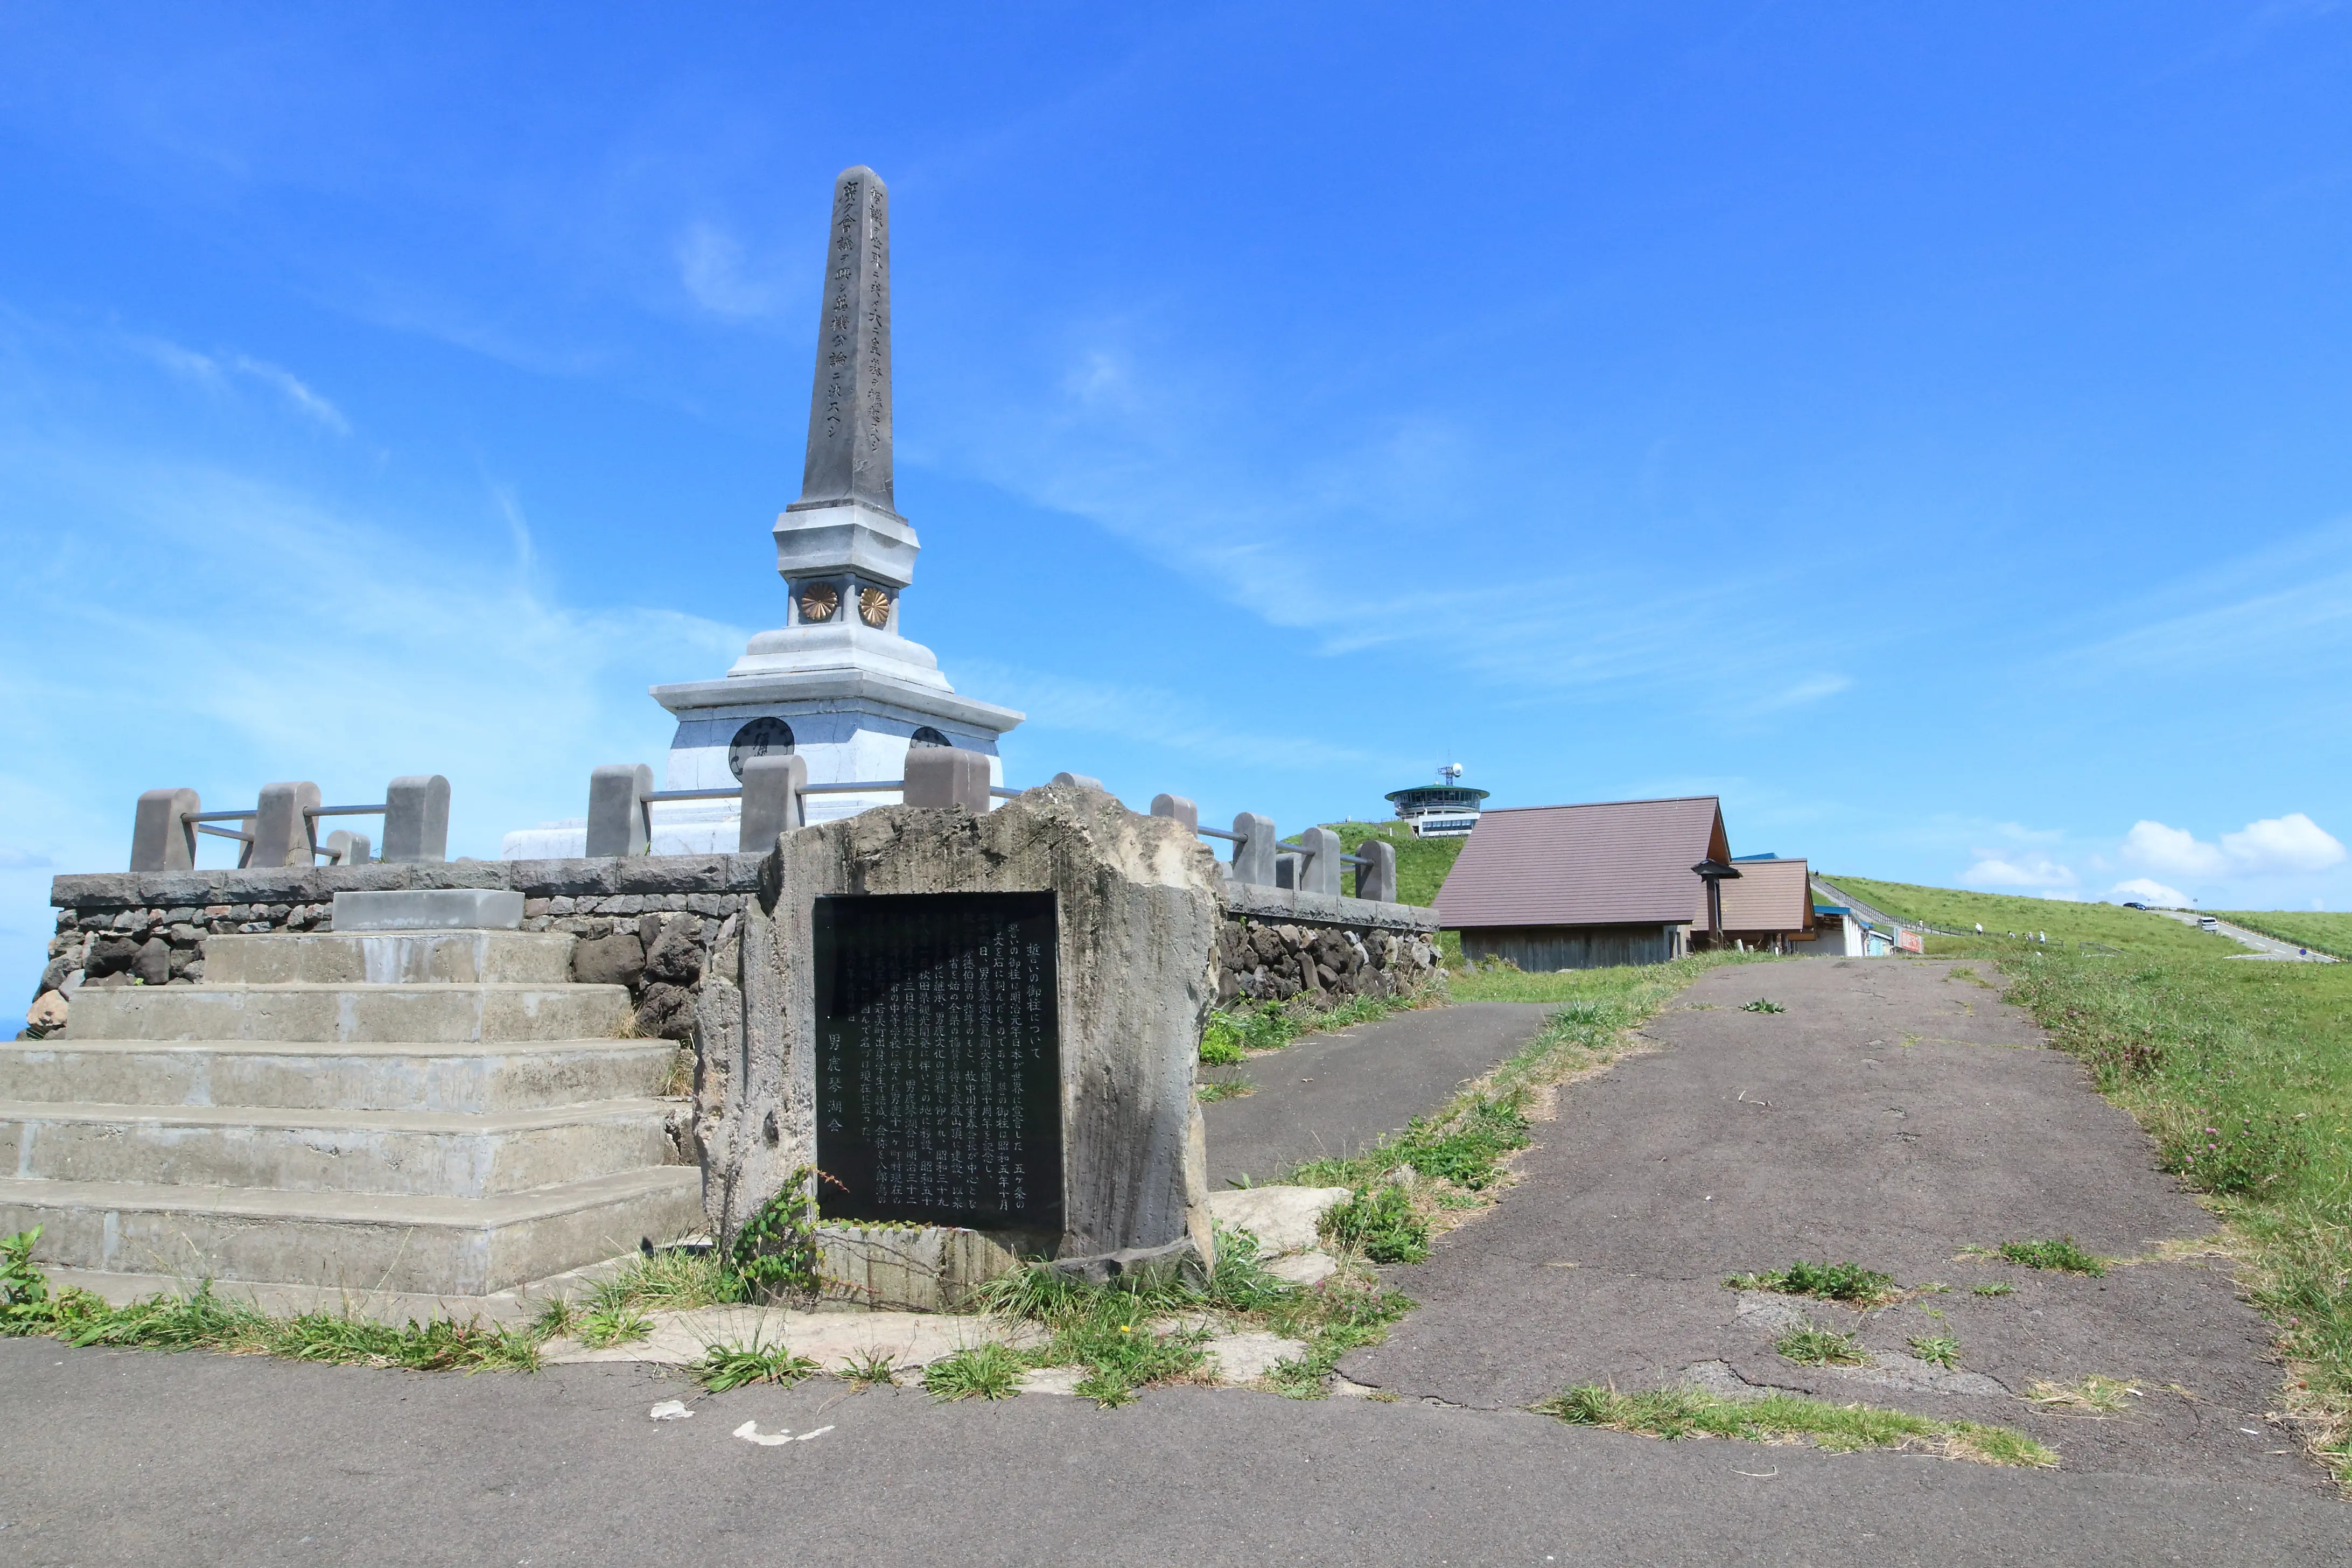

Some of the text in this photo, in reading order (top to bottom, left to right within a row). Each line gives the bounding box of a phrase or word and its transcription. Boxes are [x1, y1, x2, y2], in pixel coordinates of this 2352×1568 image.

[1026, 942, 1042, 1060] 誓いの御柱について
[827, 1033, 844, 1132] 男鹿琴湖会
